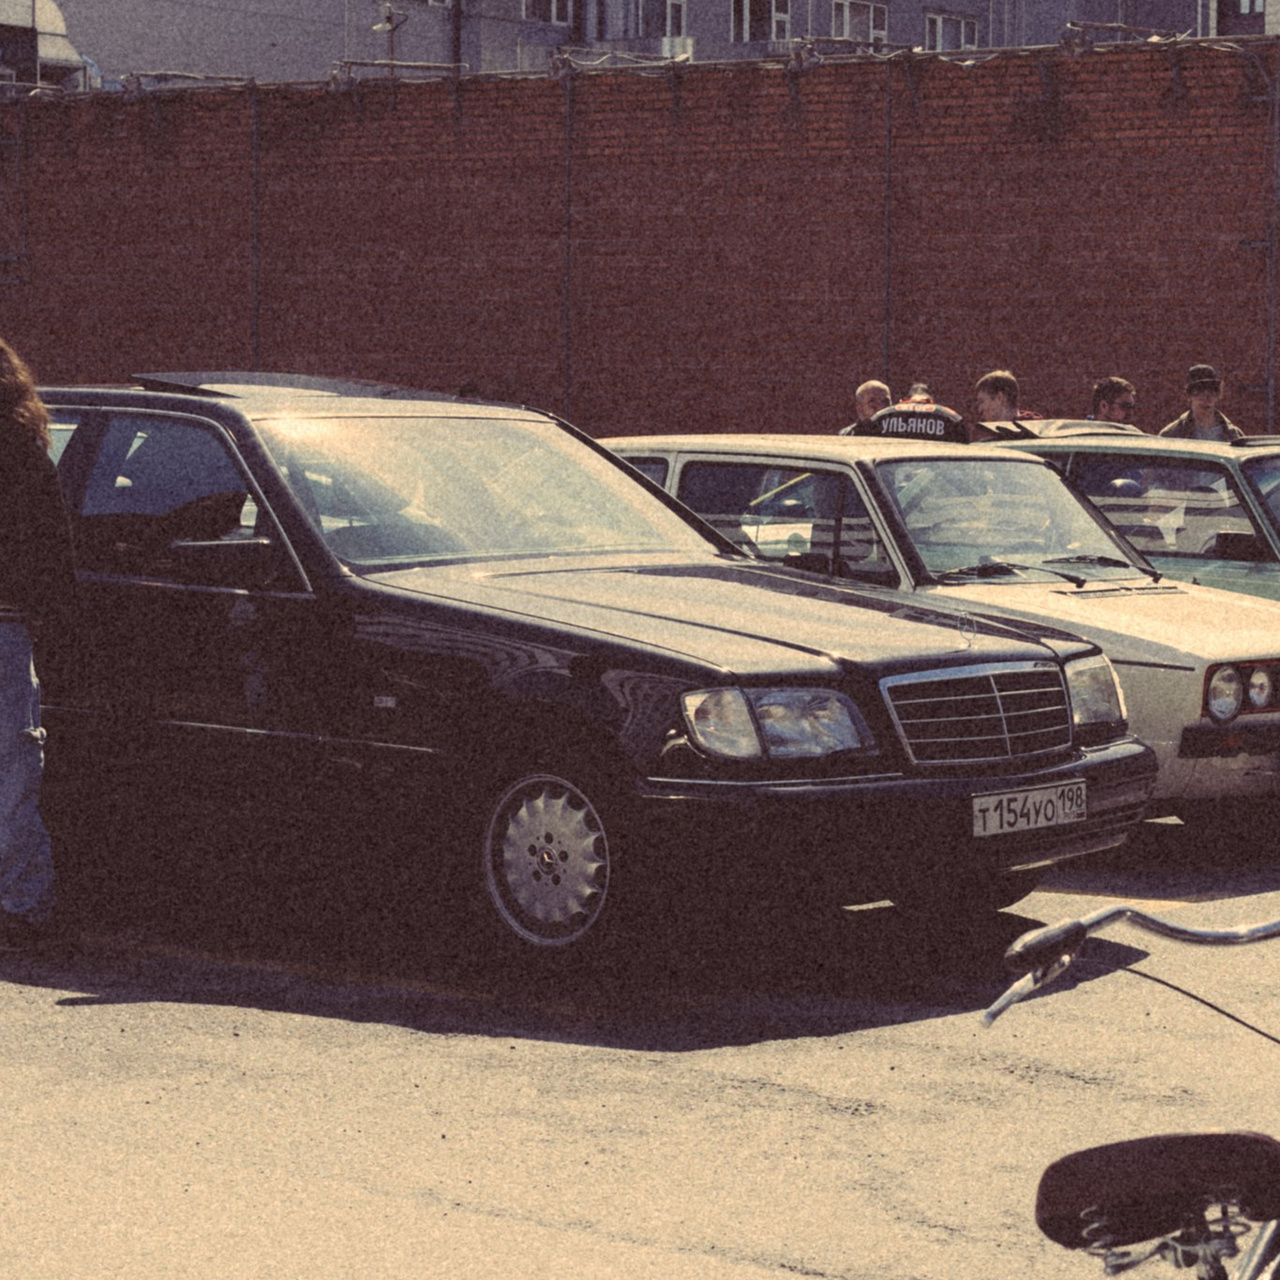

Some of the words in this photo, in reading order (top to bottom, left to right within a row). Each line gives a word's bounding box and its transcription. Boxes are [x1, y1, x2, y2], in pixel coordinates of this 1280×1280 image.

[881, 416, 945, 436] УЛЬЯНОВ
[978, 794, 1055, 832] Т154УО
[1058, 786, 1083, 811] 198
